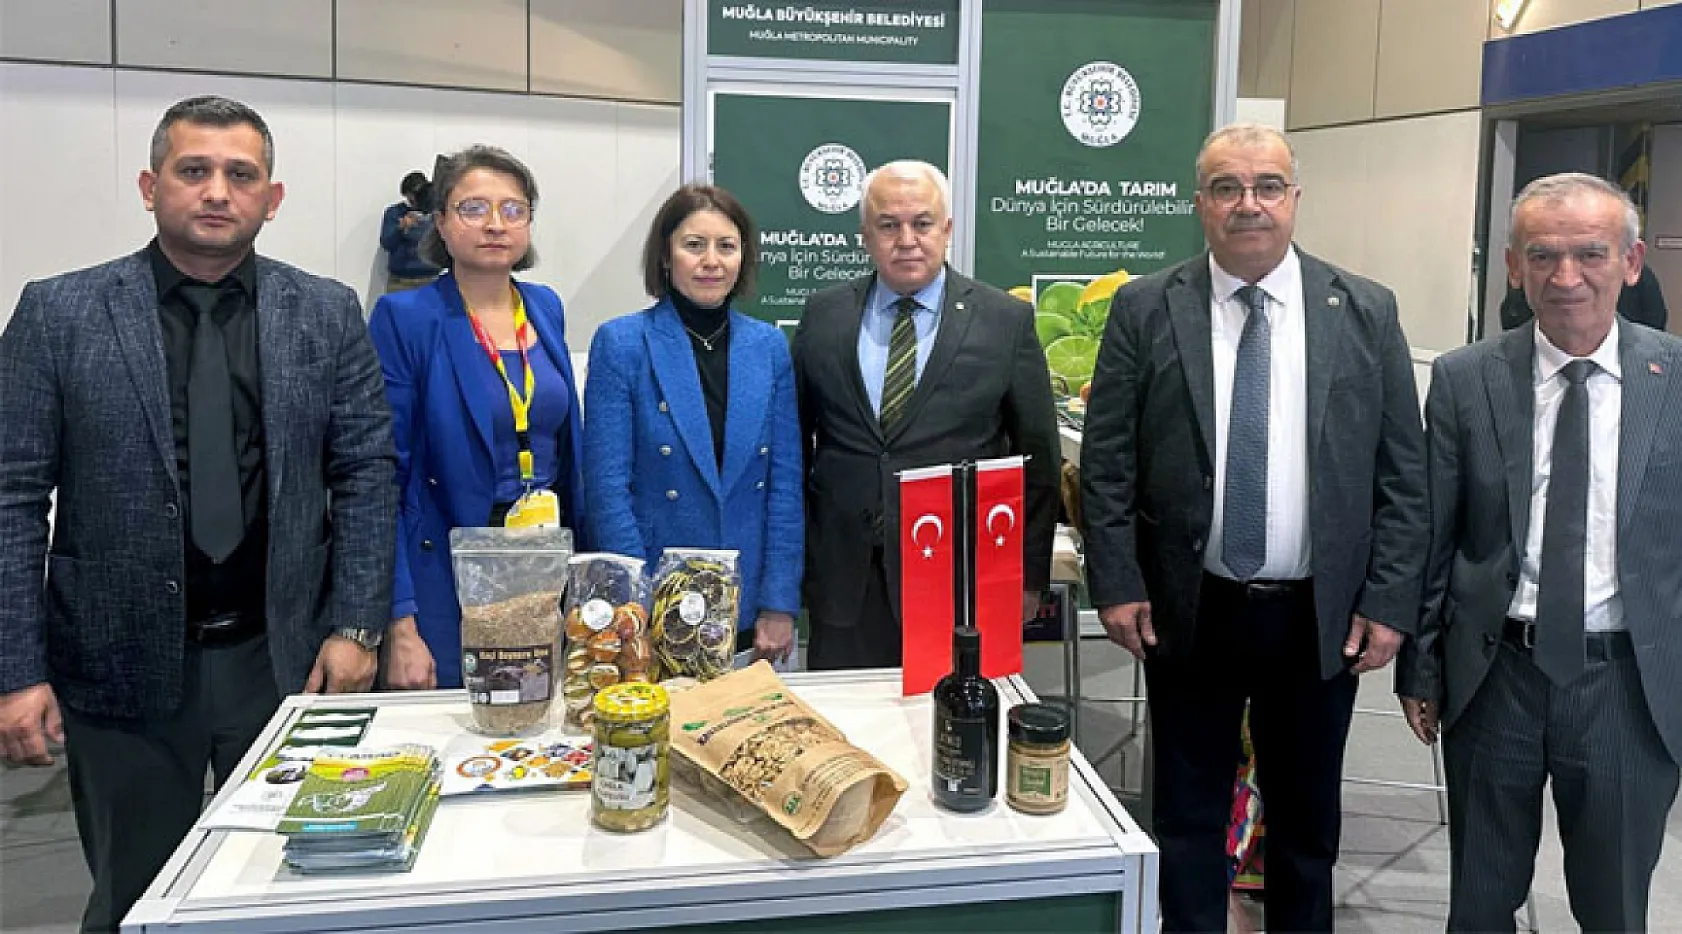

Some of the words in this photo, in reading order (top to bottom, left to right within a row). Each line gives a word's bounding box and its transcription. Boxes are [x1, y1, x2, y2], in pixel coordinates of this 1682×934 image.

[722, 4, 773, 21] MUĞLA
[776, 7, 864, 27] BÜYÜKŞEHİR
[866, 10, 945, 28] BELEDİYESİ
[1015, 176, 1112, 197] MUĞLA'DA
[1119, 180, 1177, 198] TARIM
[990, 196, 1047, 216] Dünya
[1050, 195, 1079, 218] İçin
[1083, 198, 1196, 216] Sürdürülebilir
[1045, 215, 1070, 232] Bir
[1072, 216, 1145, 233] Gelecek!
[760, 229, 848, 246] MUĞLA'DA
[760, 250, 787, 266] nya
[790, 247, 820, 266] İçin
[788, 265, 810, 280] Bir
[813, 265, 874, 280] Gelecek
